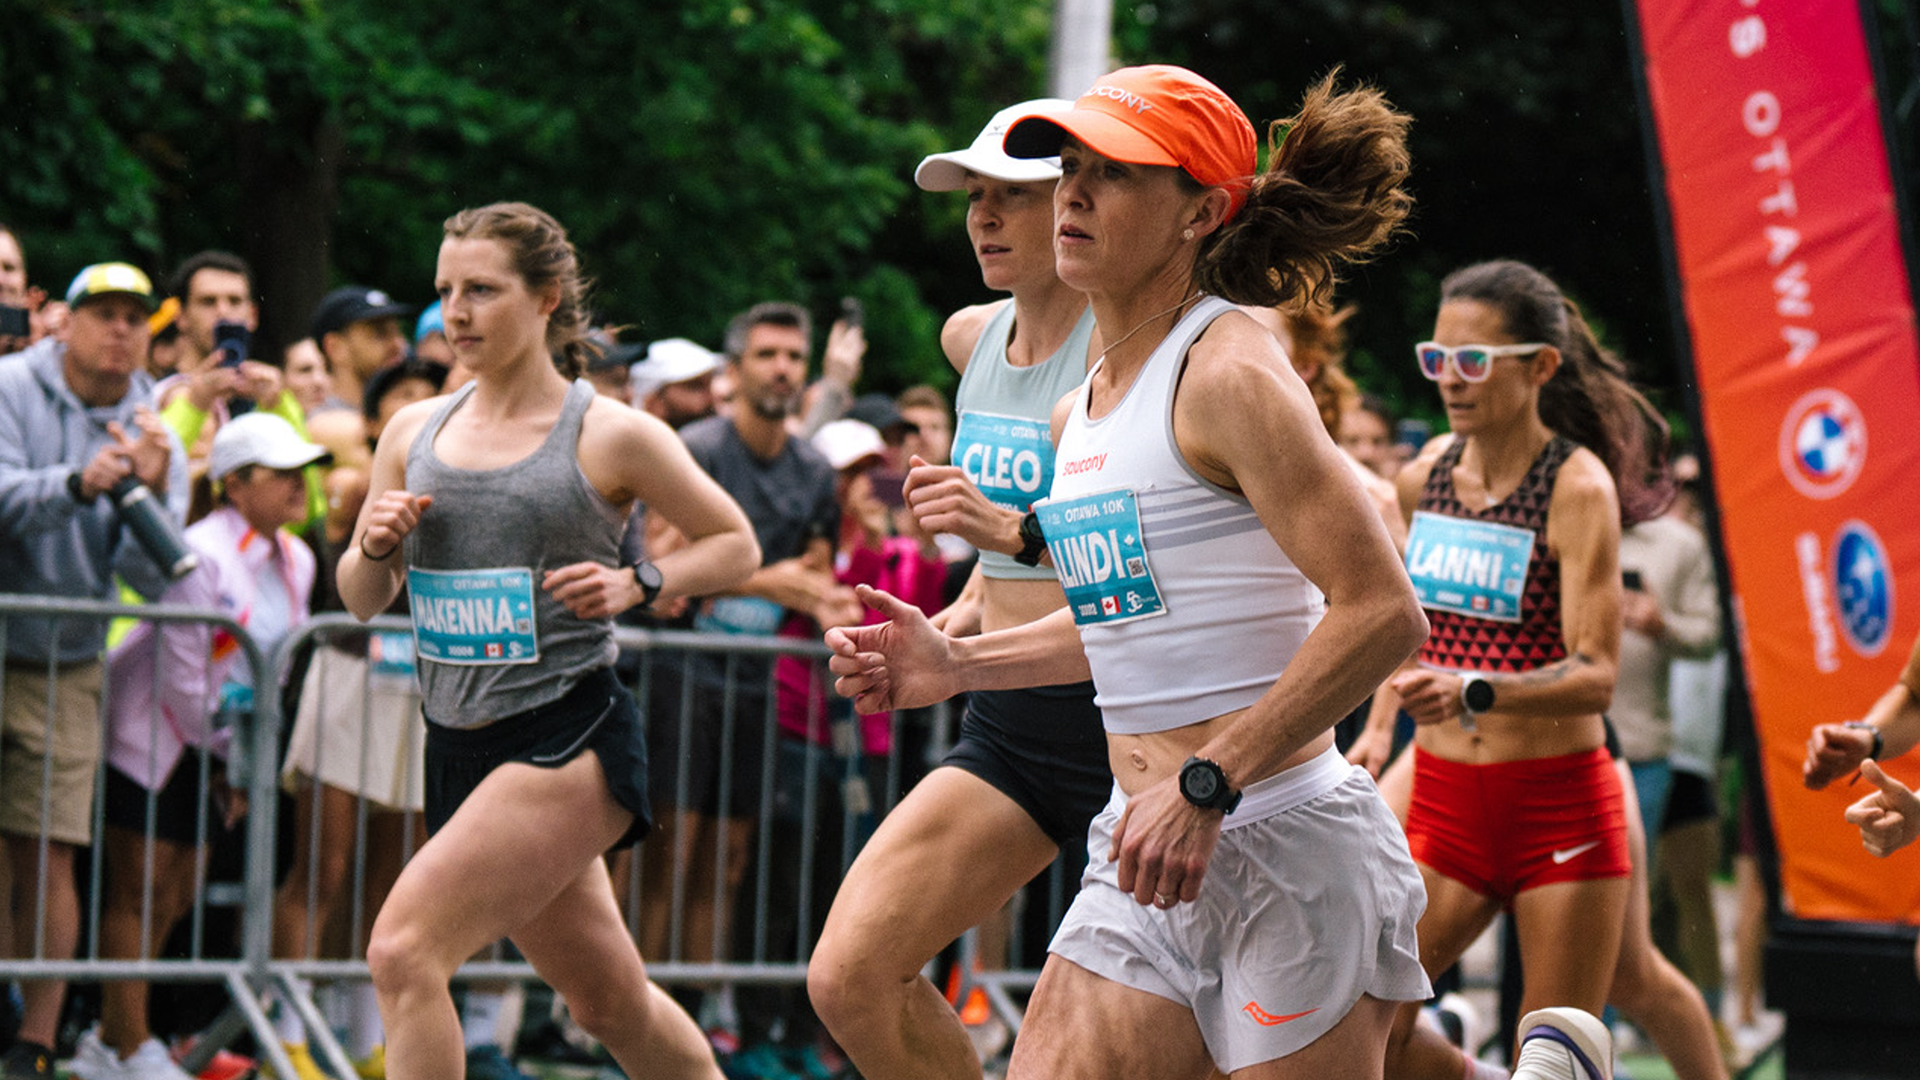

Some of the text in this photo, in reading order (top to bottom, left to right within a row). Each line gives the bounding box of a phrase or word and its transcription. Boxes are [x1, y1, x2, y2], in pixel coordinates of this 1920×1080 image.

[1743, 90, 1819, 368] OTTAWA
[962, 443, 1041, 493] CLEO
[1102, 499, 1125, 516] 10K
[452, 578, 497, 591] OTTAWA
[1409, 540, 1503, 590] LANNI
[414, 593, 515, 636] MAKENNA
